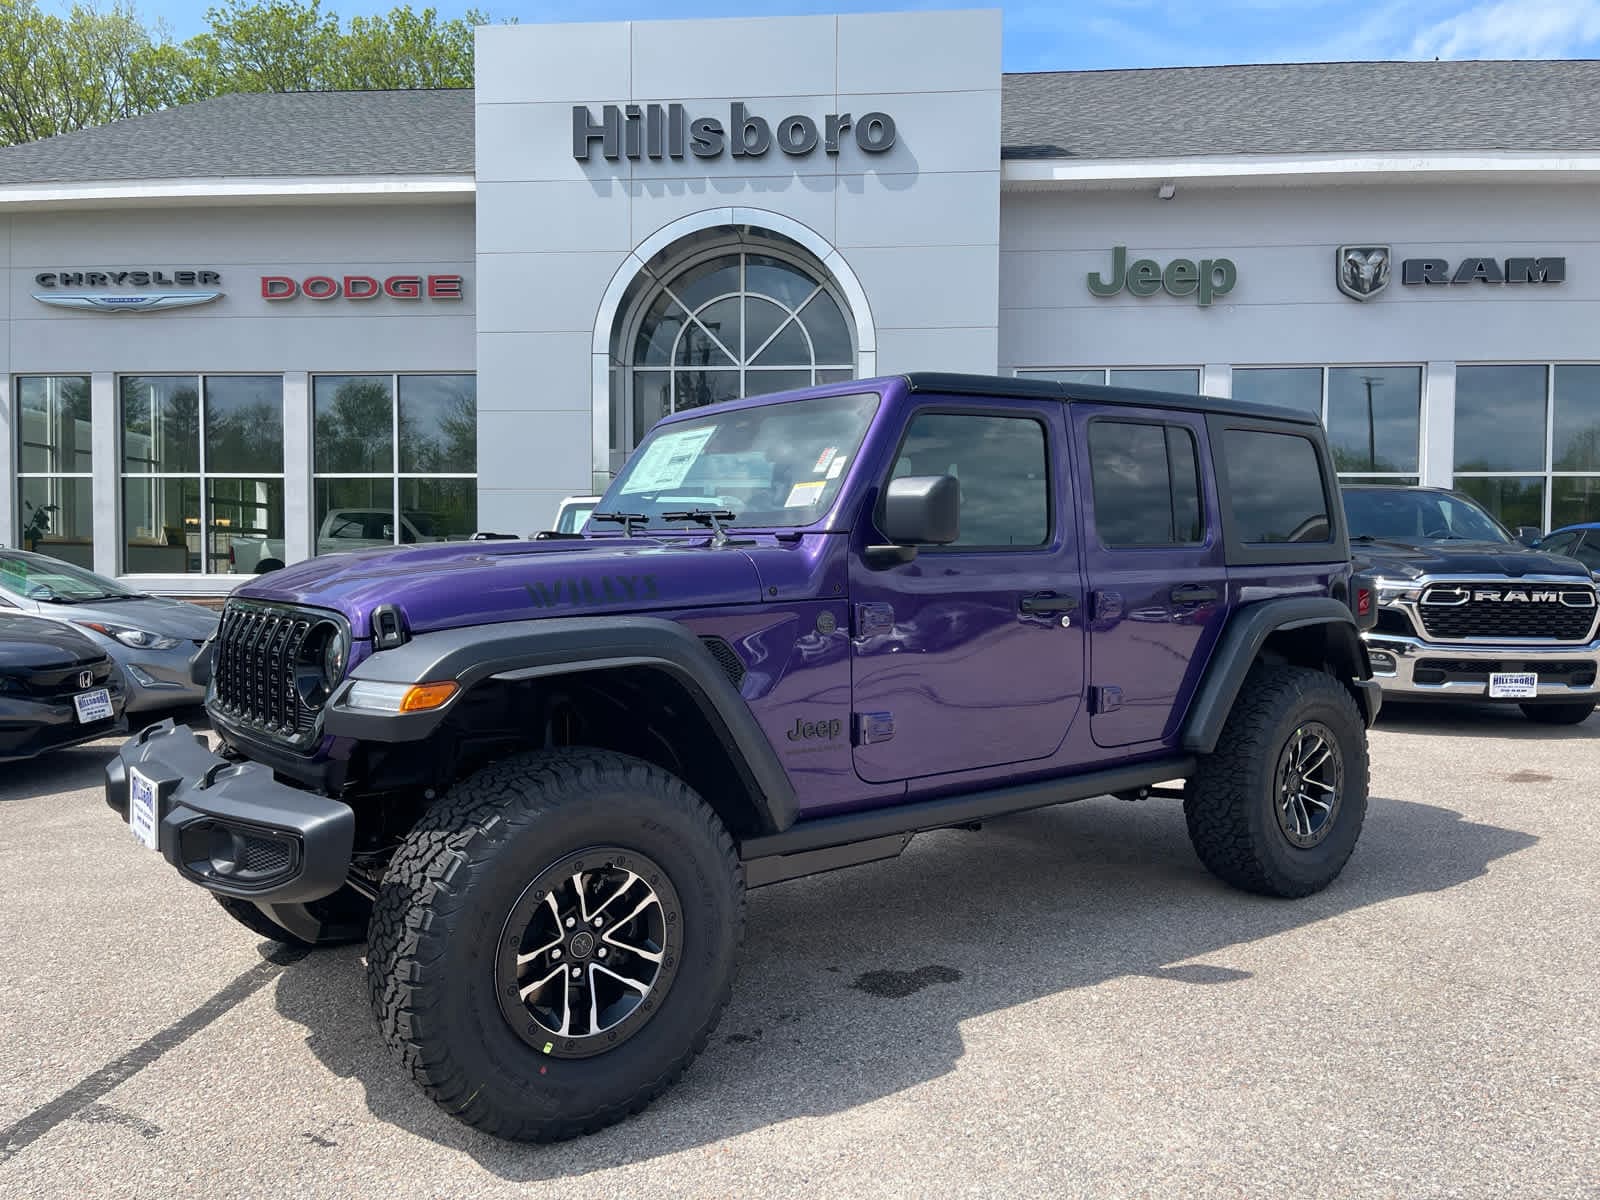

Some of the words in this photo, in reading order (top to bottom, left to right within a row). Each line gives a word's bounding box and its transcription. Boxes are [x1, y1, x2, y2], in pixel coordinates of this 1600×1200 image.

[572, 101, 897, 159] Hillsboro
[35, 271, 221, 287] CHRYSLER
[1087, 246, 1237, 306] Jeep
[1402, 257, 1566, 285] RAM
[260, 275, 463, 300] DODGE
[525, 574, 657, 608] WILLYS
[1474, 590, 1558, 602] RAM
[787, 718, 841, 741] Jeep
